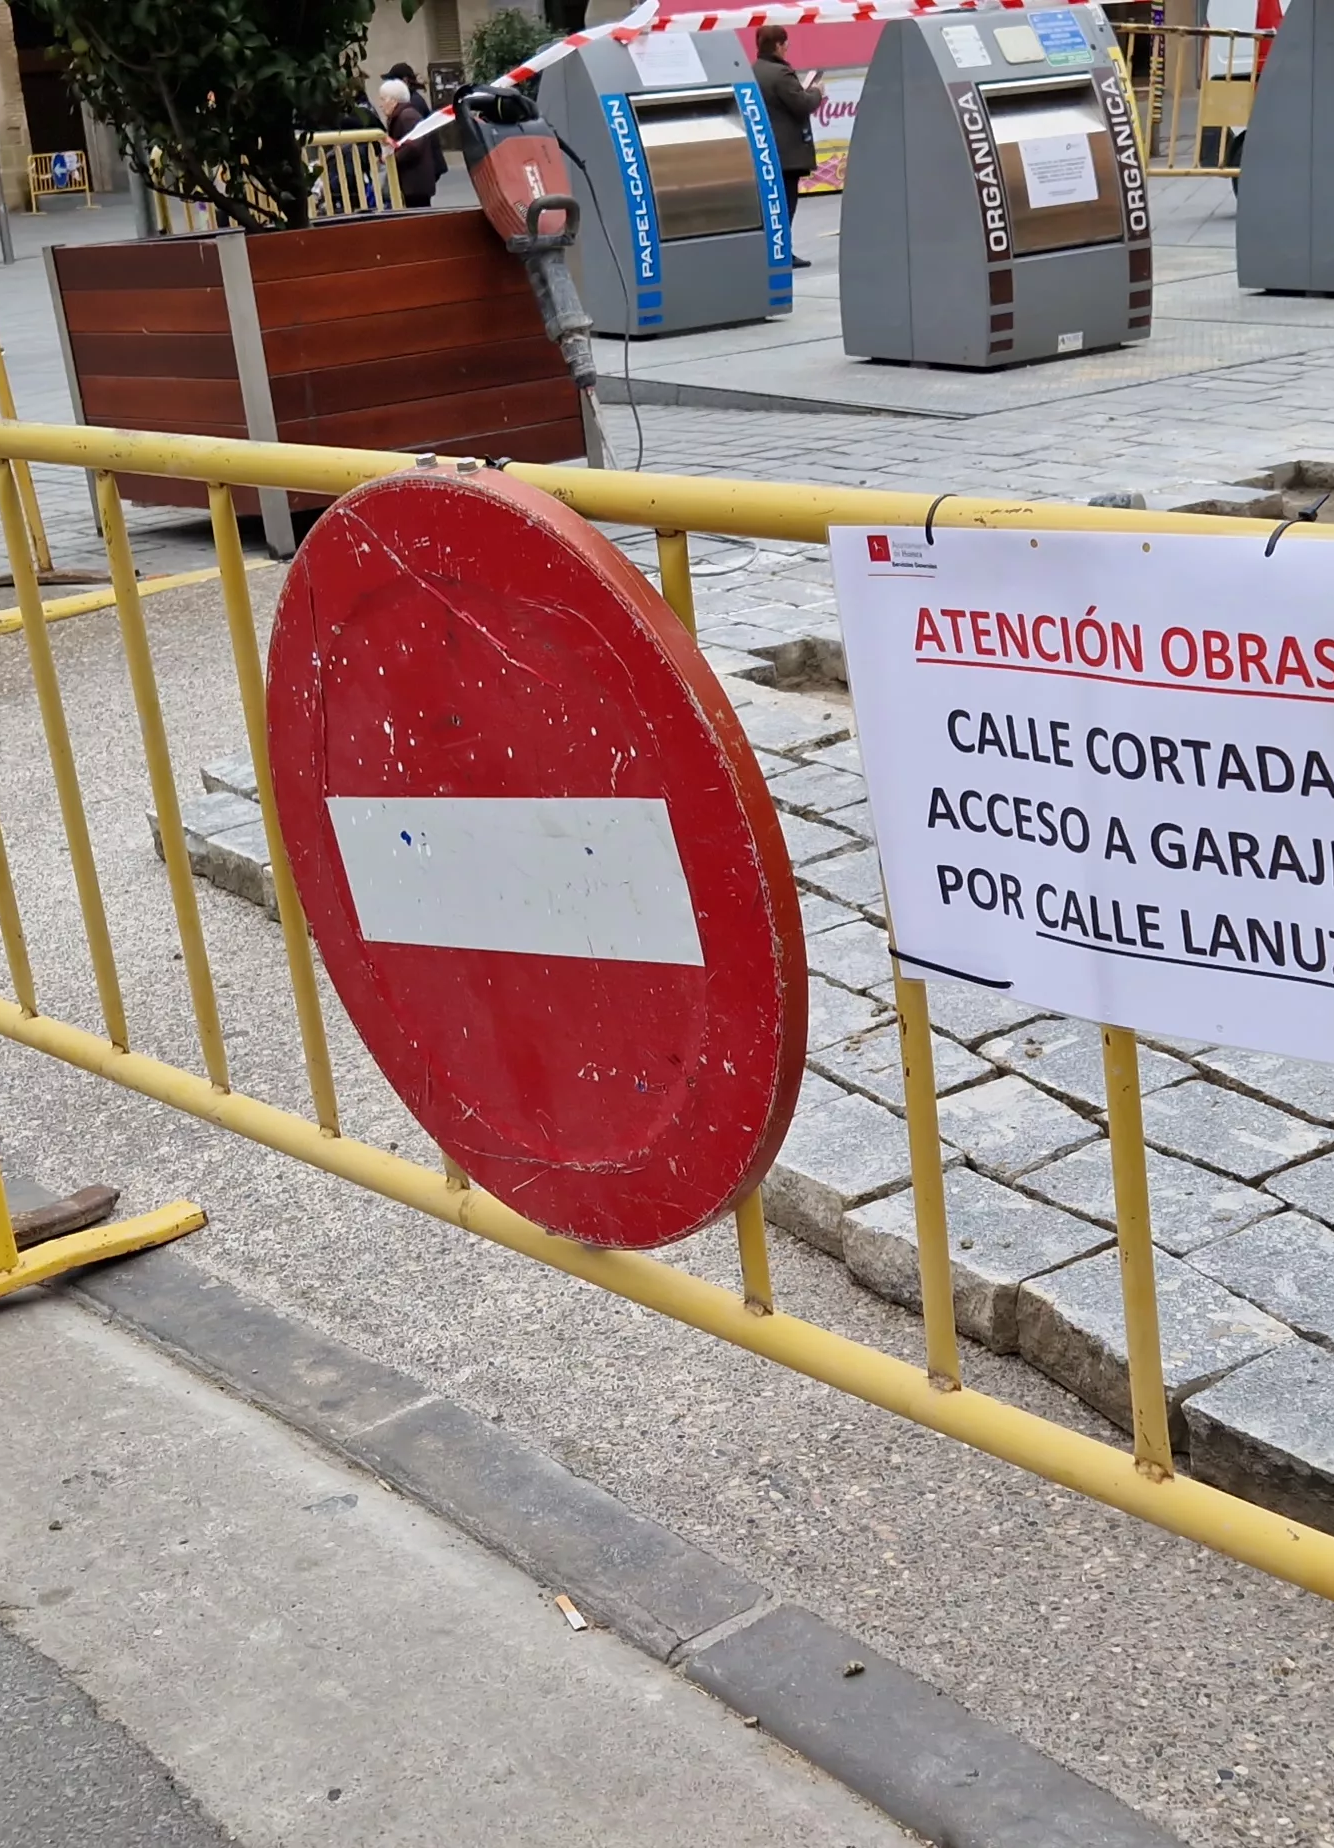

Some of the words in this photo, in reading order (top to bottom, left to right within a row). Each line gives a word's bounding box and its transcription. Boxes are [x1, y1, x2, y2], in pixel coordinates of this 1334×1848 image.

[608, 99, 654, 279] PAPEL-CARTÓN
[740, 88, 785, 260] PAPEL-CARTÓN
[957, 91, 1007, 253] ORGÁNICA
[1101, 76, 1147, 232] ORGÁNICA
[914, 605, 1144, 673] ATENCIÓN
[947, 708, 1074, 767] CALLE
[927, 786, 1090, 853] ACCESO
[1104, 816, 1136, 864] A
[937, 863, 1023, 920] POR
[1035, 882, 1163, 949] CALLE
